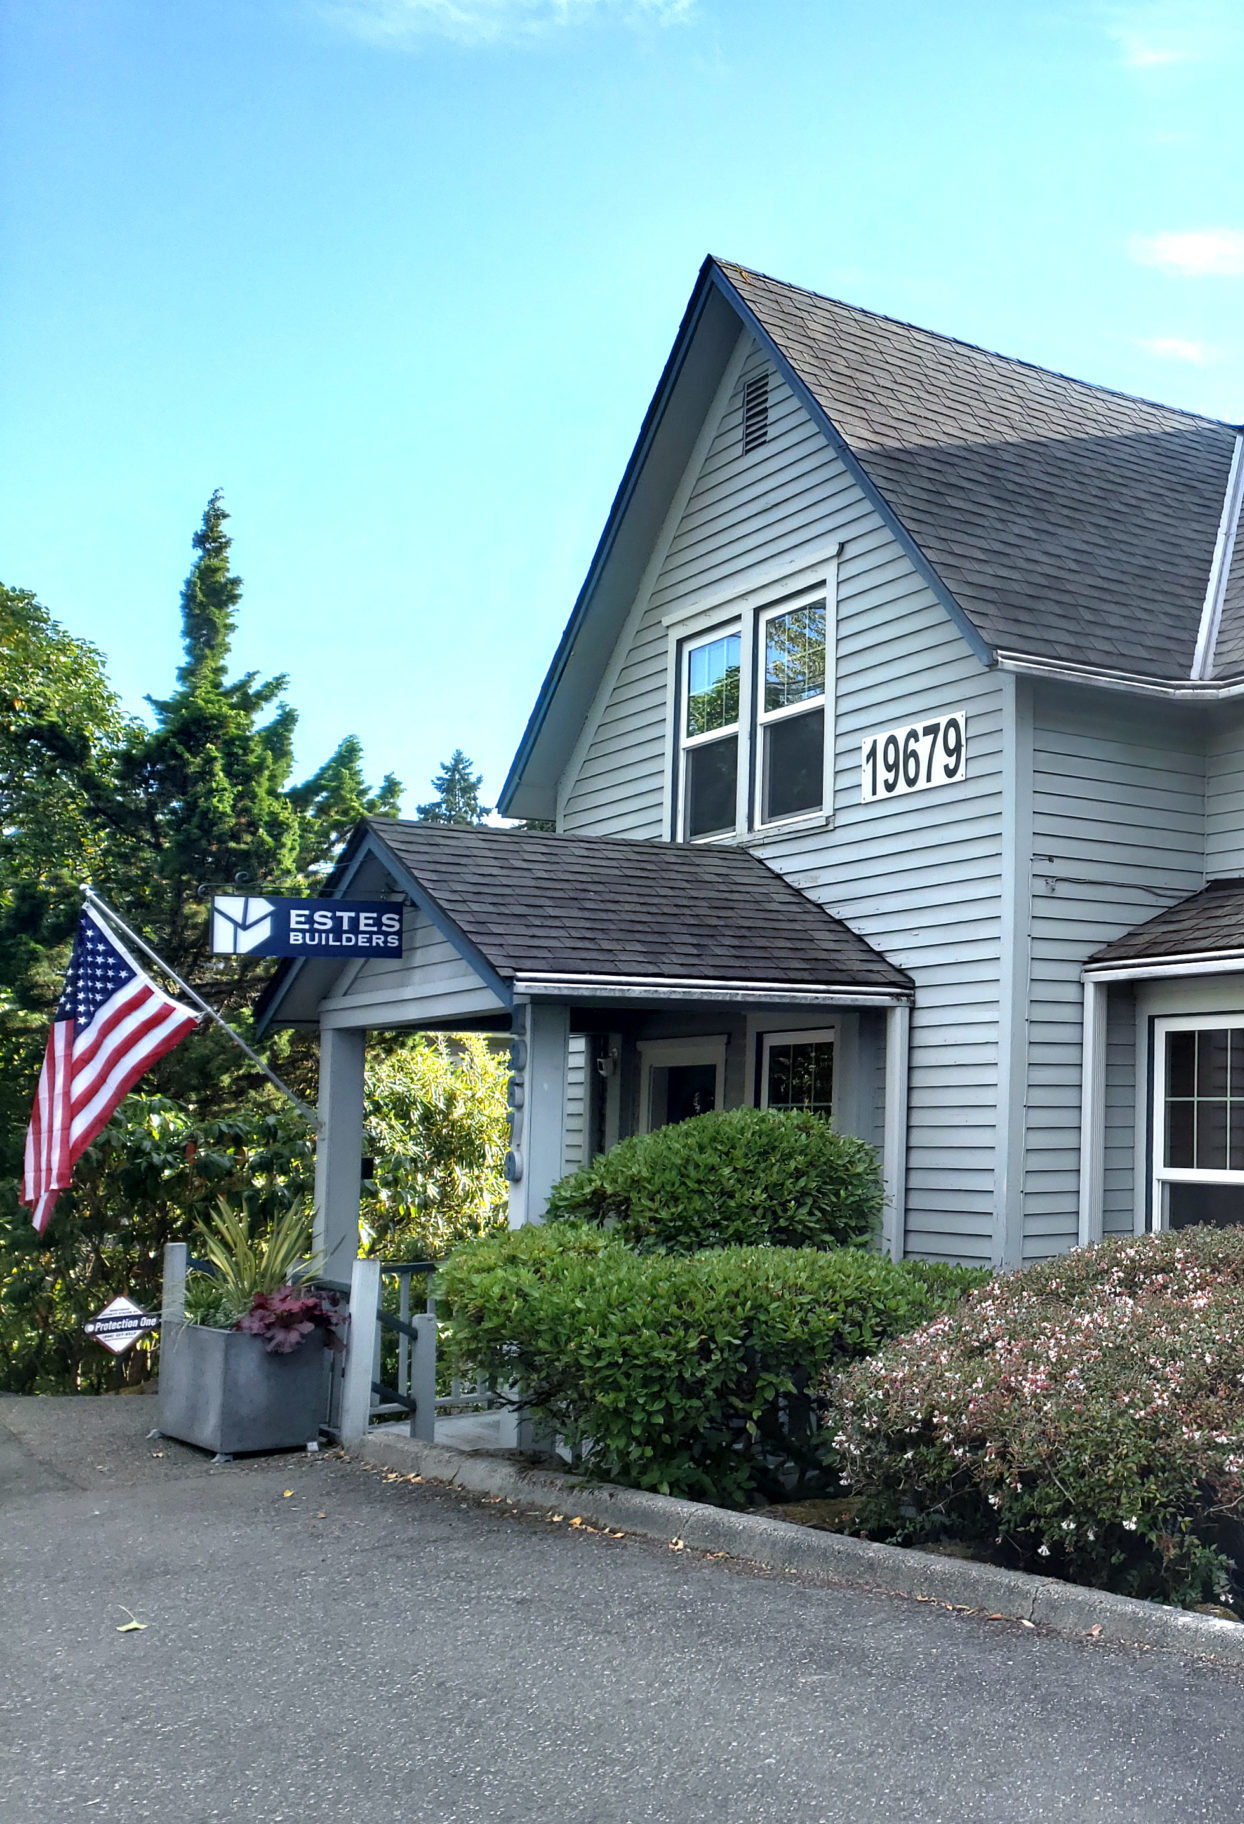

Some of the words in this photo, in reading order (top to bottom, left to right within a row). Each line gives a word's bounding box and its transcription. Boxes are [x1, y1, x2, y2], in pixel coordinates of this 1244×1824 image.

[865, 717, 963, 796] 19679
[289, 909, 400, 931] ESTES
[289, 932, 399, 947] BUILDERS
[94, 1318, 138, 1332] Protection
[140, 1316, 157, 1326] One
